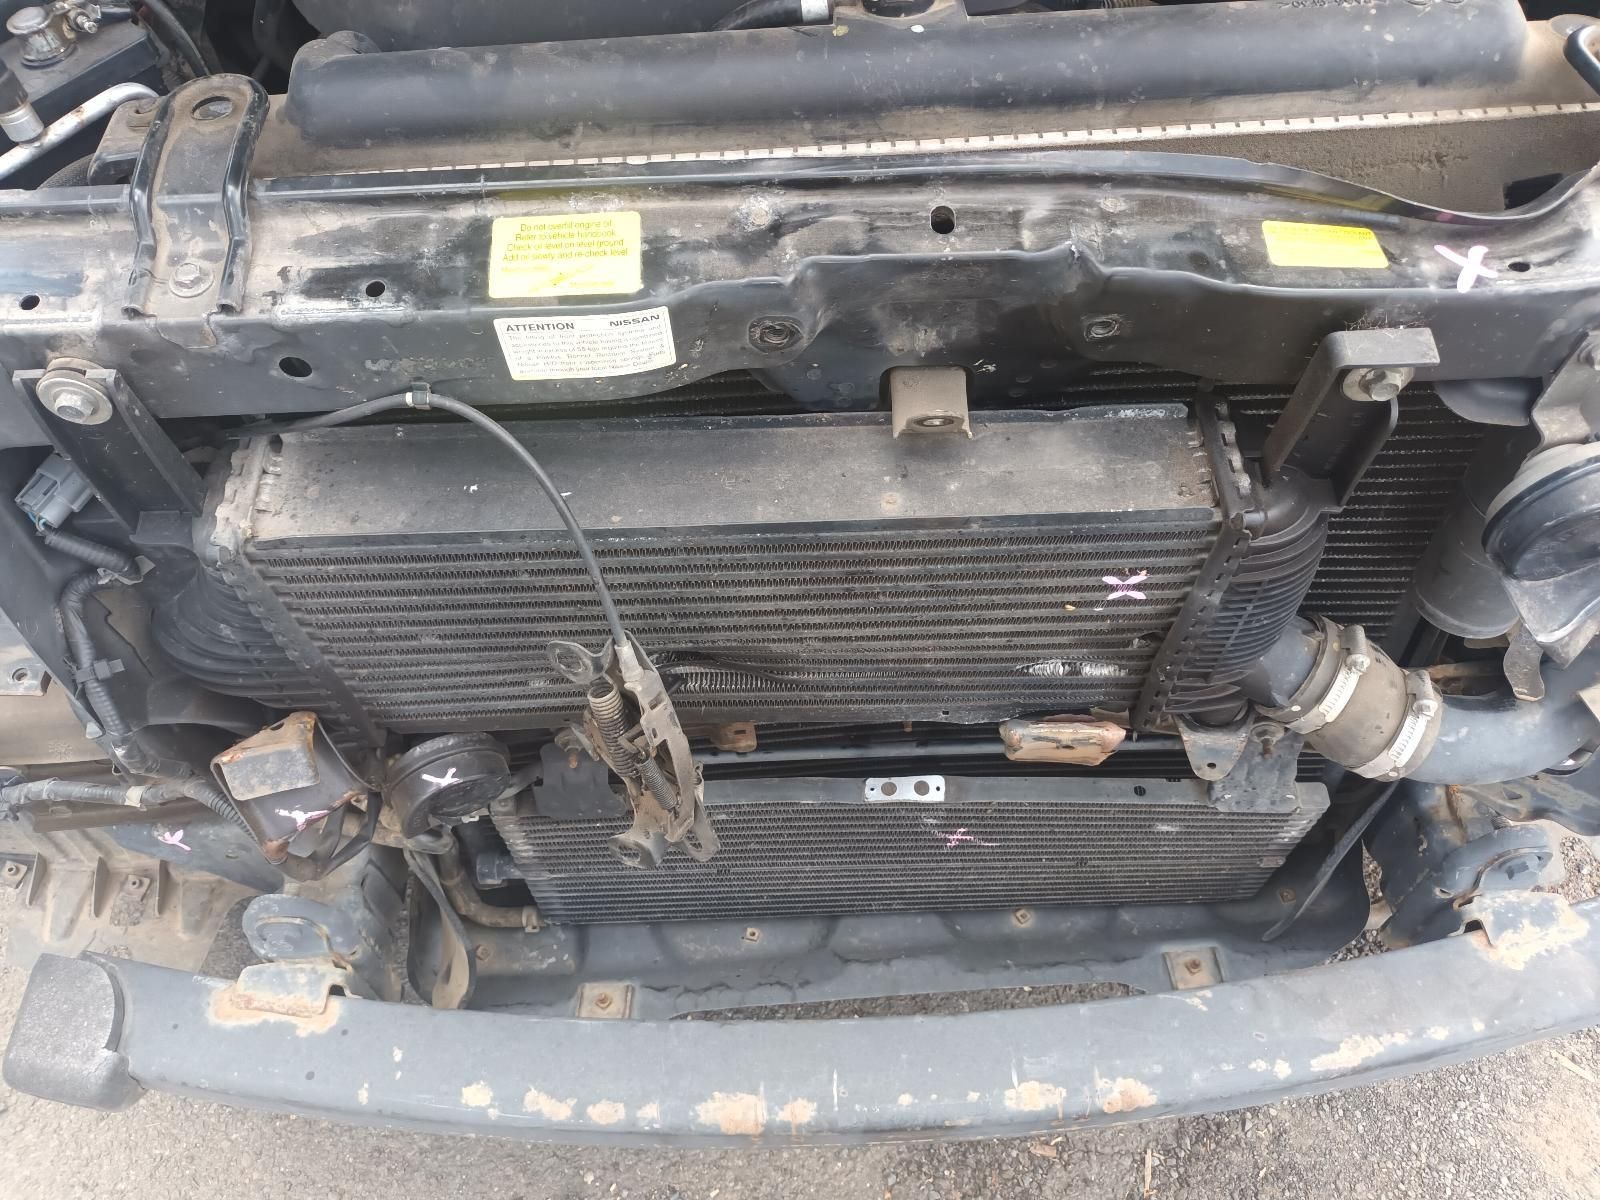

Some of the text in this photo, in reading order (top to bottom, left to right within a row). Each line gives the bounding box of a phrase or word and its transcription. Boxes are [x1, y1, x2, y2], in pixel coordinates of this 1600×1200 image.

[520, 223, 532, 232] Do
[533, 223, 546, 231] not
[515, 232, 537, 241] Refer
[548, 231, 575, 240] vehicle
[506, 243, 531, 252] Check
[596, 238, 624, 248] ground
[610, 248, 628, 256] level
[506, 314, 660, 332] ATTENTION NISSAN
